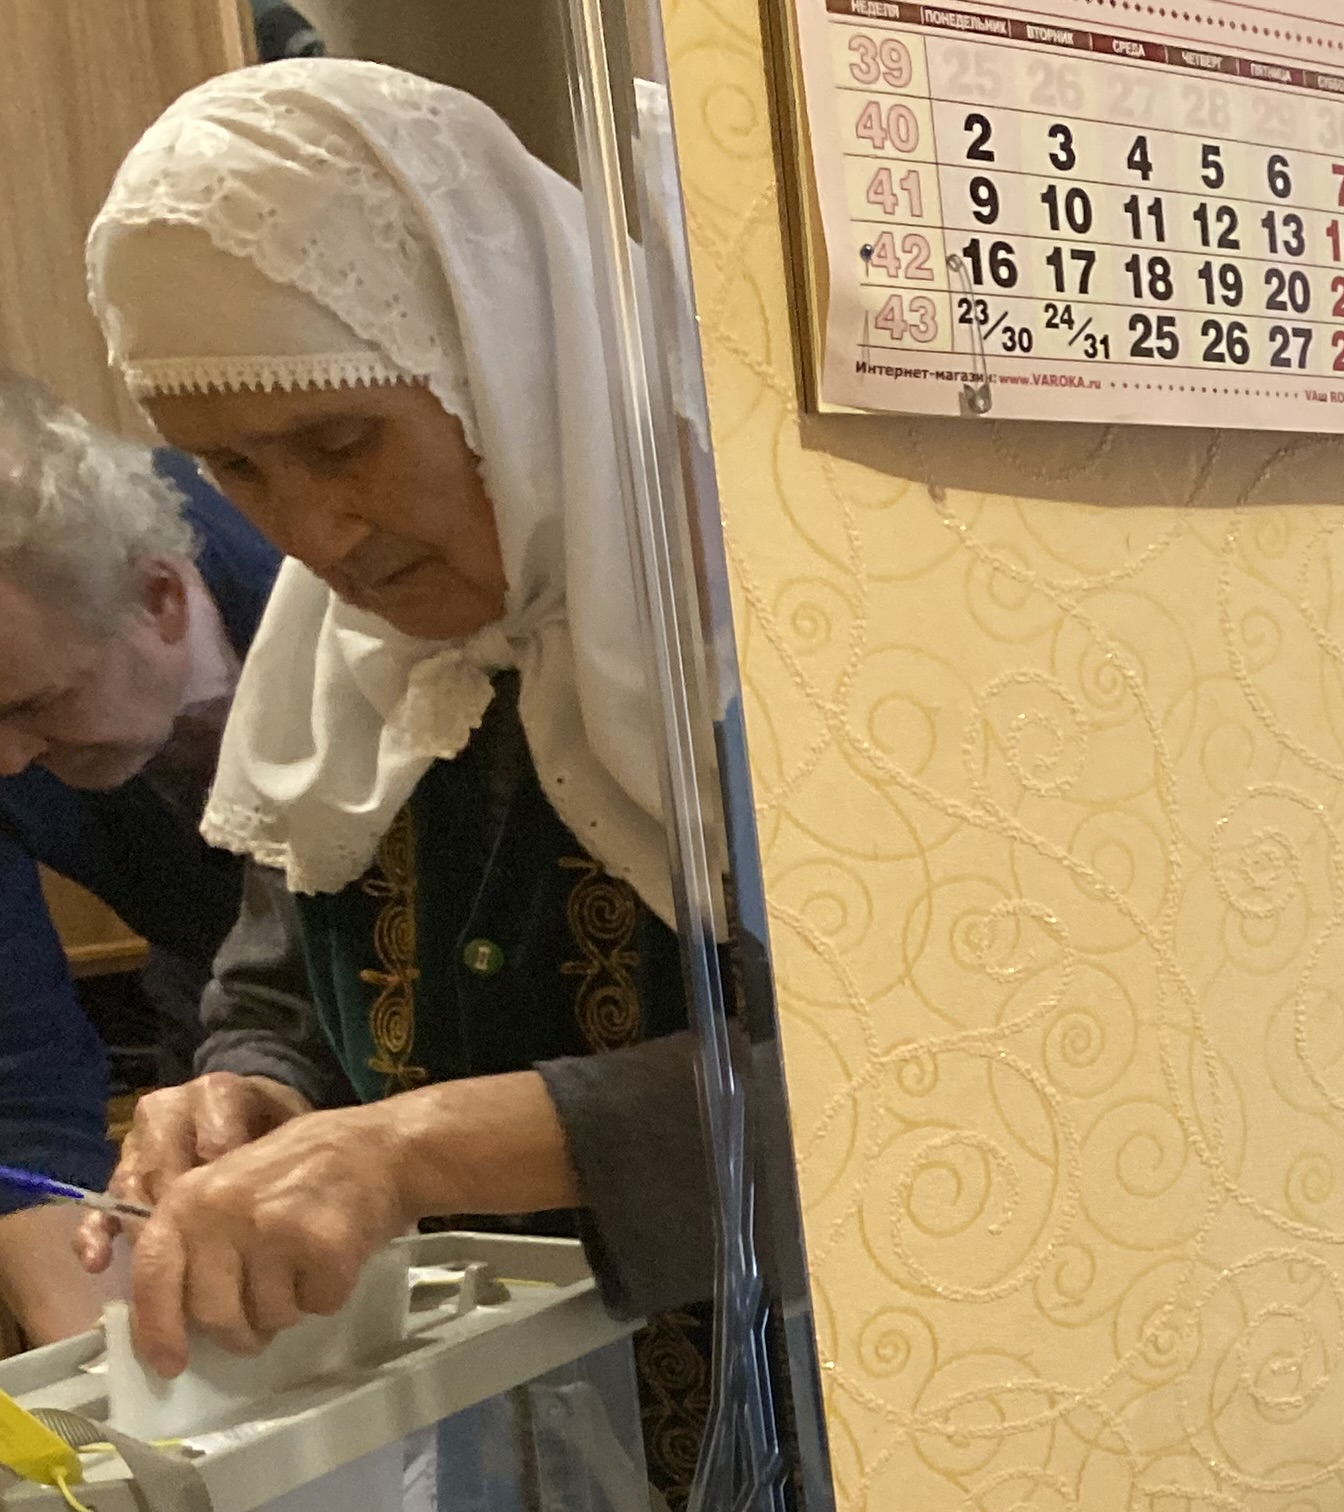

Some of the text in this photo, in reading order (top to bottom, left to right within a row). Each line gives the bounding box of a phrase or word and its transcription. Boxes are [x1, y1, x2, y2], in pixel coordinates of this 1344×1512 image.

[848, 34, 912, 88] 39
[943, 46, 999, 98] 25
[1027, 58, 1086, 111] 26
[924, 9, 1007, 35] ПОНЕДЕЛЬНИК
[1026, 24, 1074, 46] ВТОРНИК
[1112, 39, 1145, 57] СРЕДА
[1181, 51, 1223, 70] ЧЕТВЕРГ
[855, 101, 919, 152] 40
[963, 113, 995, 162] 2
[1047, 123, 1076, 171] 3
[1126, 135, 1153, 181] 4
[1200, 143, 1225, 190] 5
[1267, 154, 1292, 199] 6
[866, 168, 923, 217] 41
[969, 176, 999, 225] 9
[1040, 184, 1093, 234] 10
[1123, 194, 1166, 243] 11
[1192, 202, 1241, 250] 12
[1260, 210, 1305, 257] 13
[871, 231, 935, 281] 42
[962, 238, 1018, 289] 16
[1046, 246, 1096, 295] 17
[1124, 253, 1174, 301] 18
[1197, 260, 1243, 308] 19
[1263, 267, 1311, 314] 20
[874, 293, 938, 343] 43
[1128, 313, 1180, 360] 25
[1200, 319, 1250, 365] 26
[1268, 325, 1313, 369] 27
